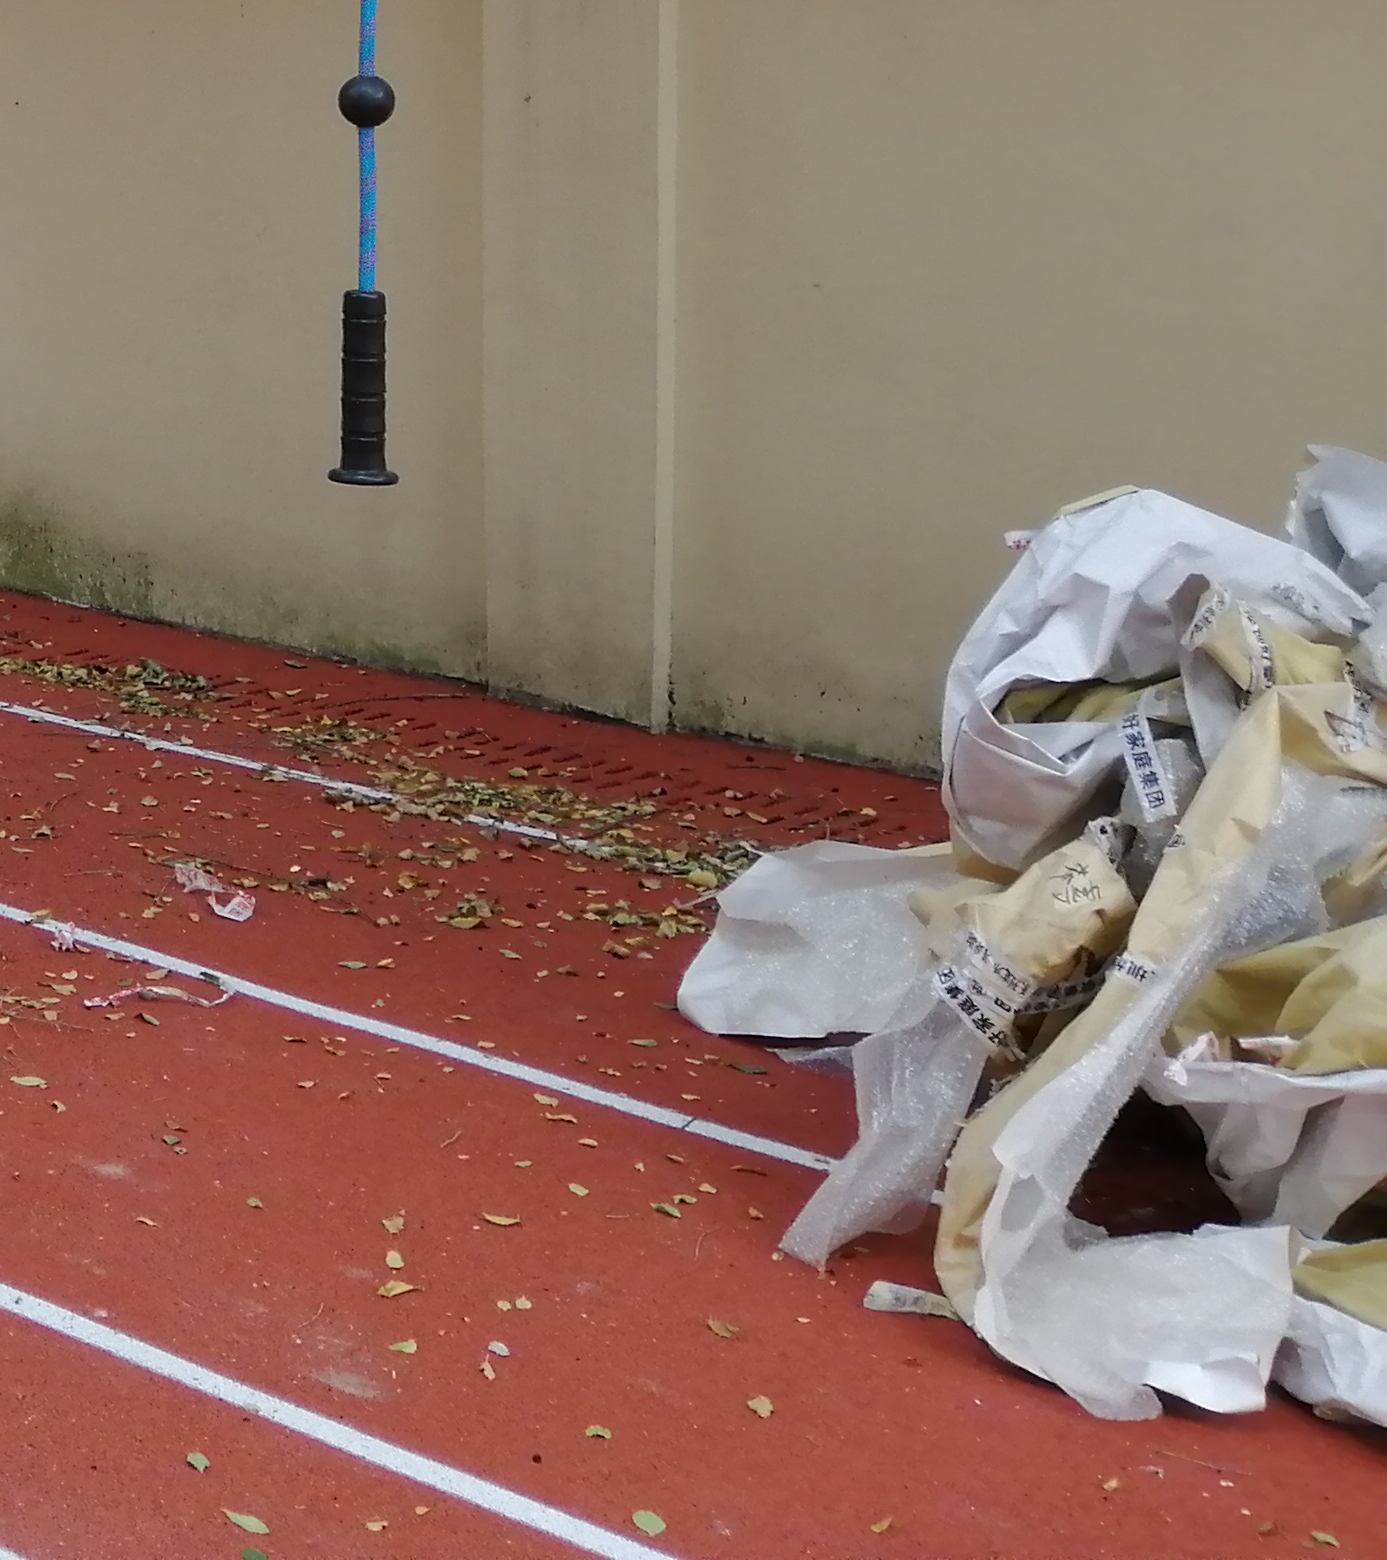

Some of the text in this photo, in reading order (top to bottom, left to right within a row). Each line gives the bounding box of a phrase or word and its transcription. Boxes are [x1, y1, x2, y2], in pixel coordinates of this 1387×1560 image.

[1122, 713, 1165, 809] 好家庭集团
